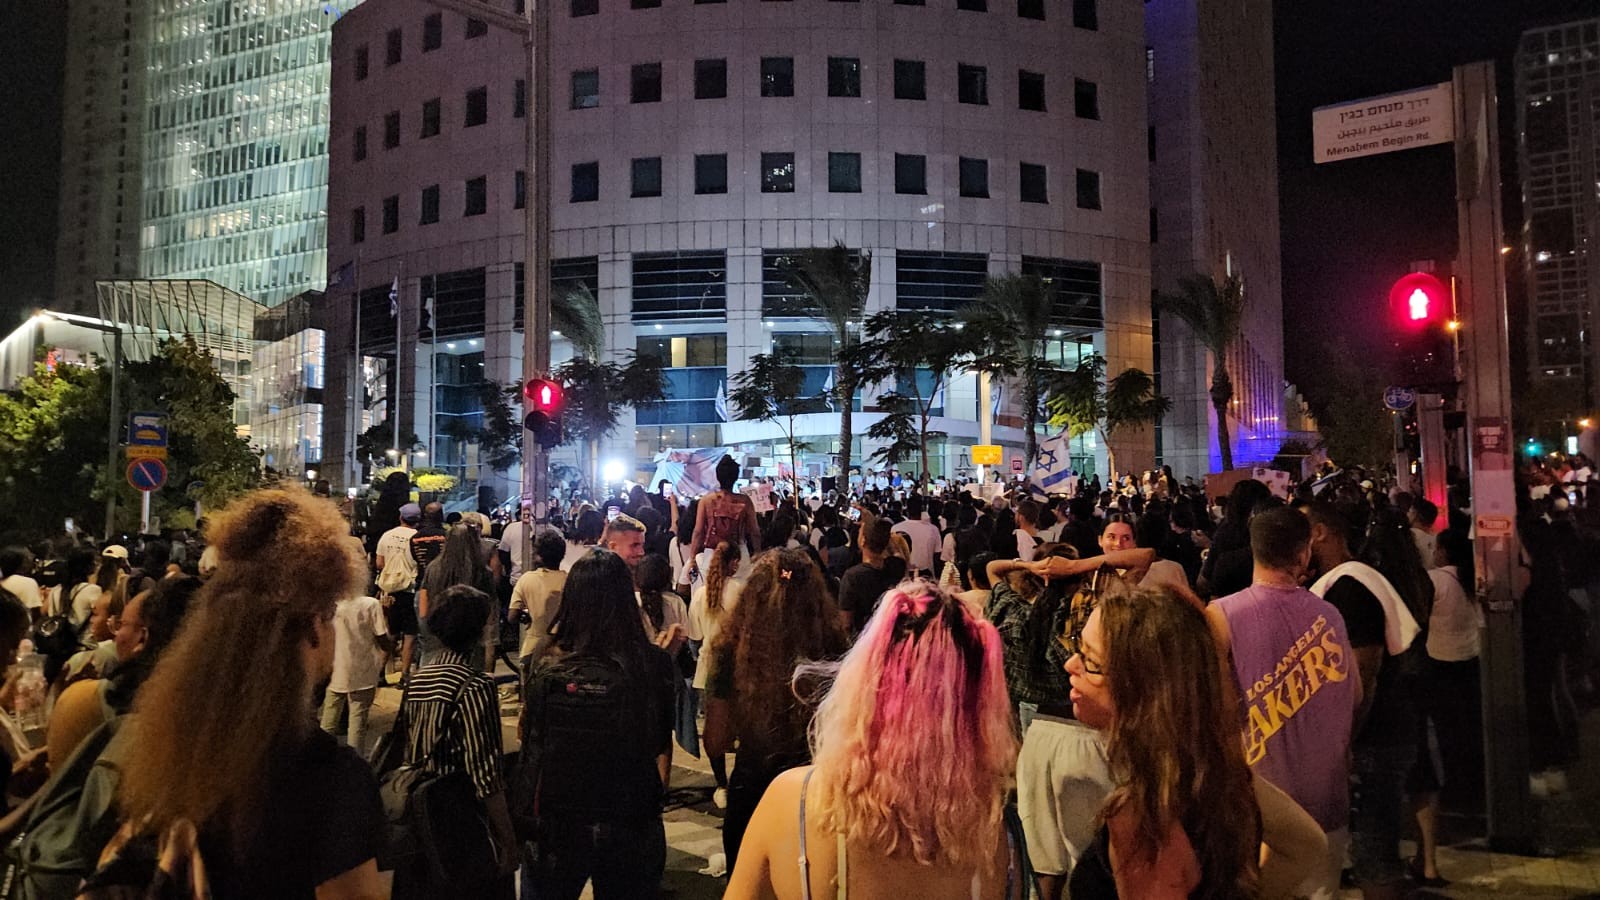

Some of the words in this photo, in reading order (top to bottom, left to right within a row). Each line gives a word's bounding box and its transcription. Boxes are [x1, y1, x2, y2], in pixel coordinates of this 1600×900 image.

[1367, 102, 1404, 116] מנחם
[1407, 97, 1429, 110] דרך
[1339, 109, 1364, 124] בגין
[1382, 135, 1414, 147] Begin
[1246, 672, 1274, 702] LOS
[1275, 614, 1328, 678] ANGELES
